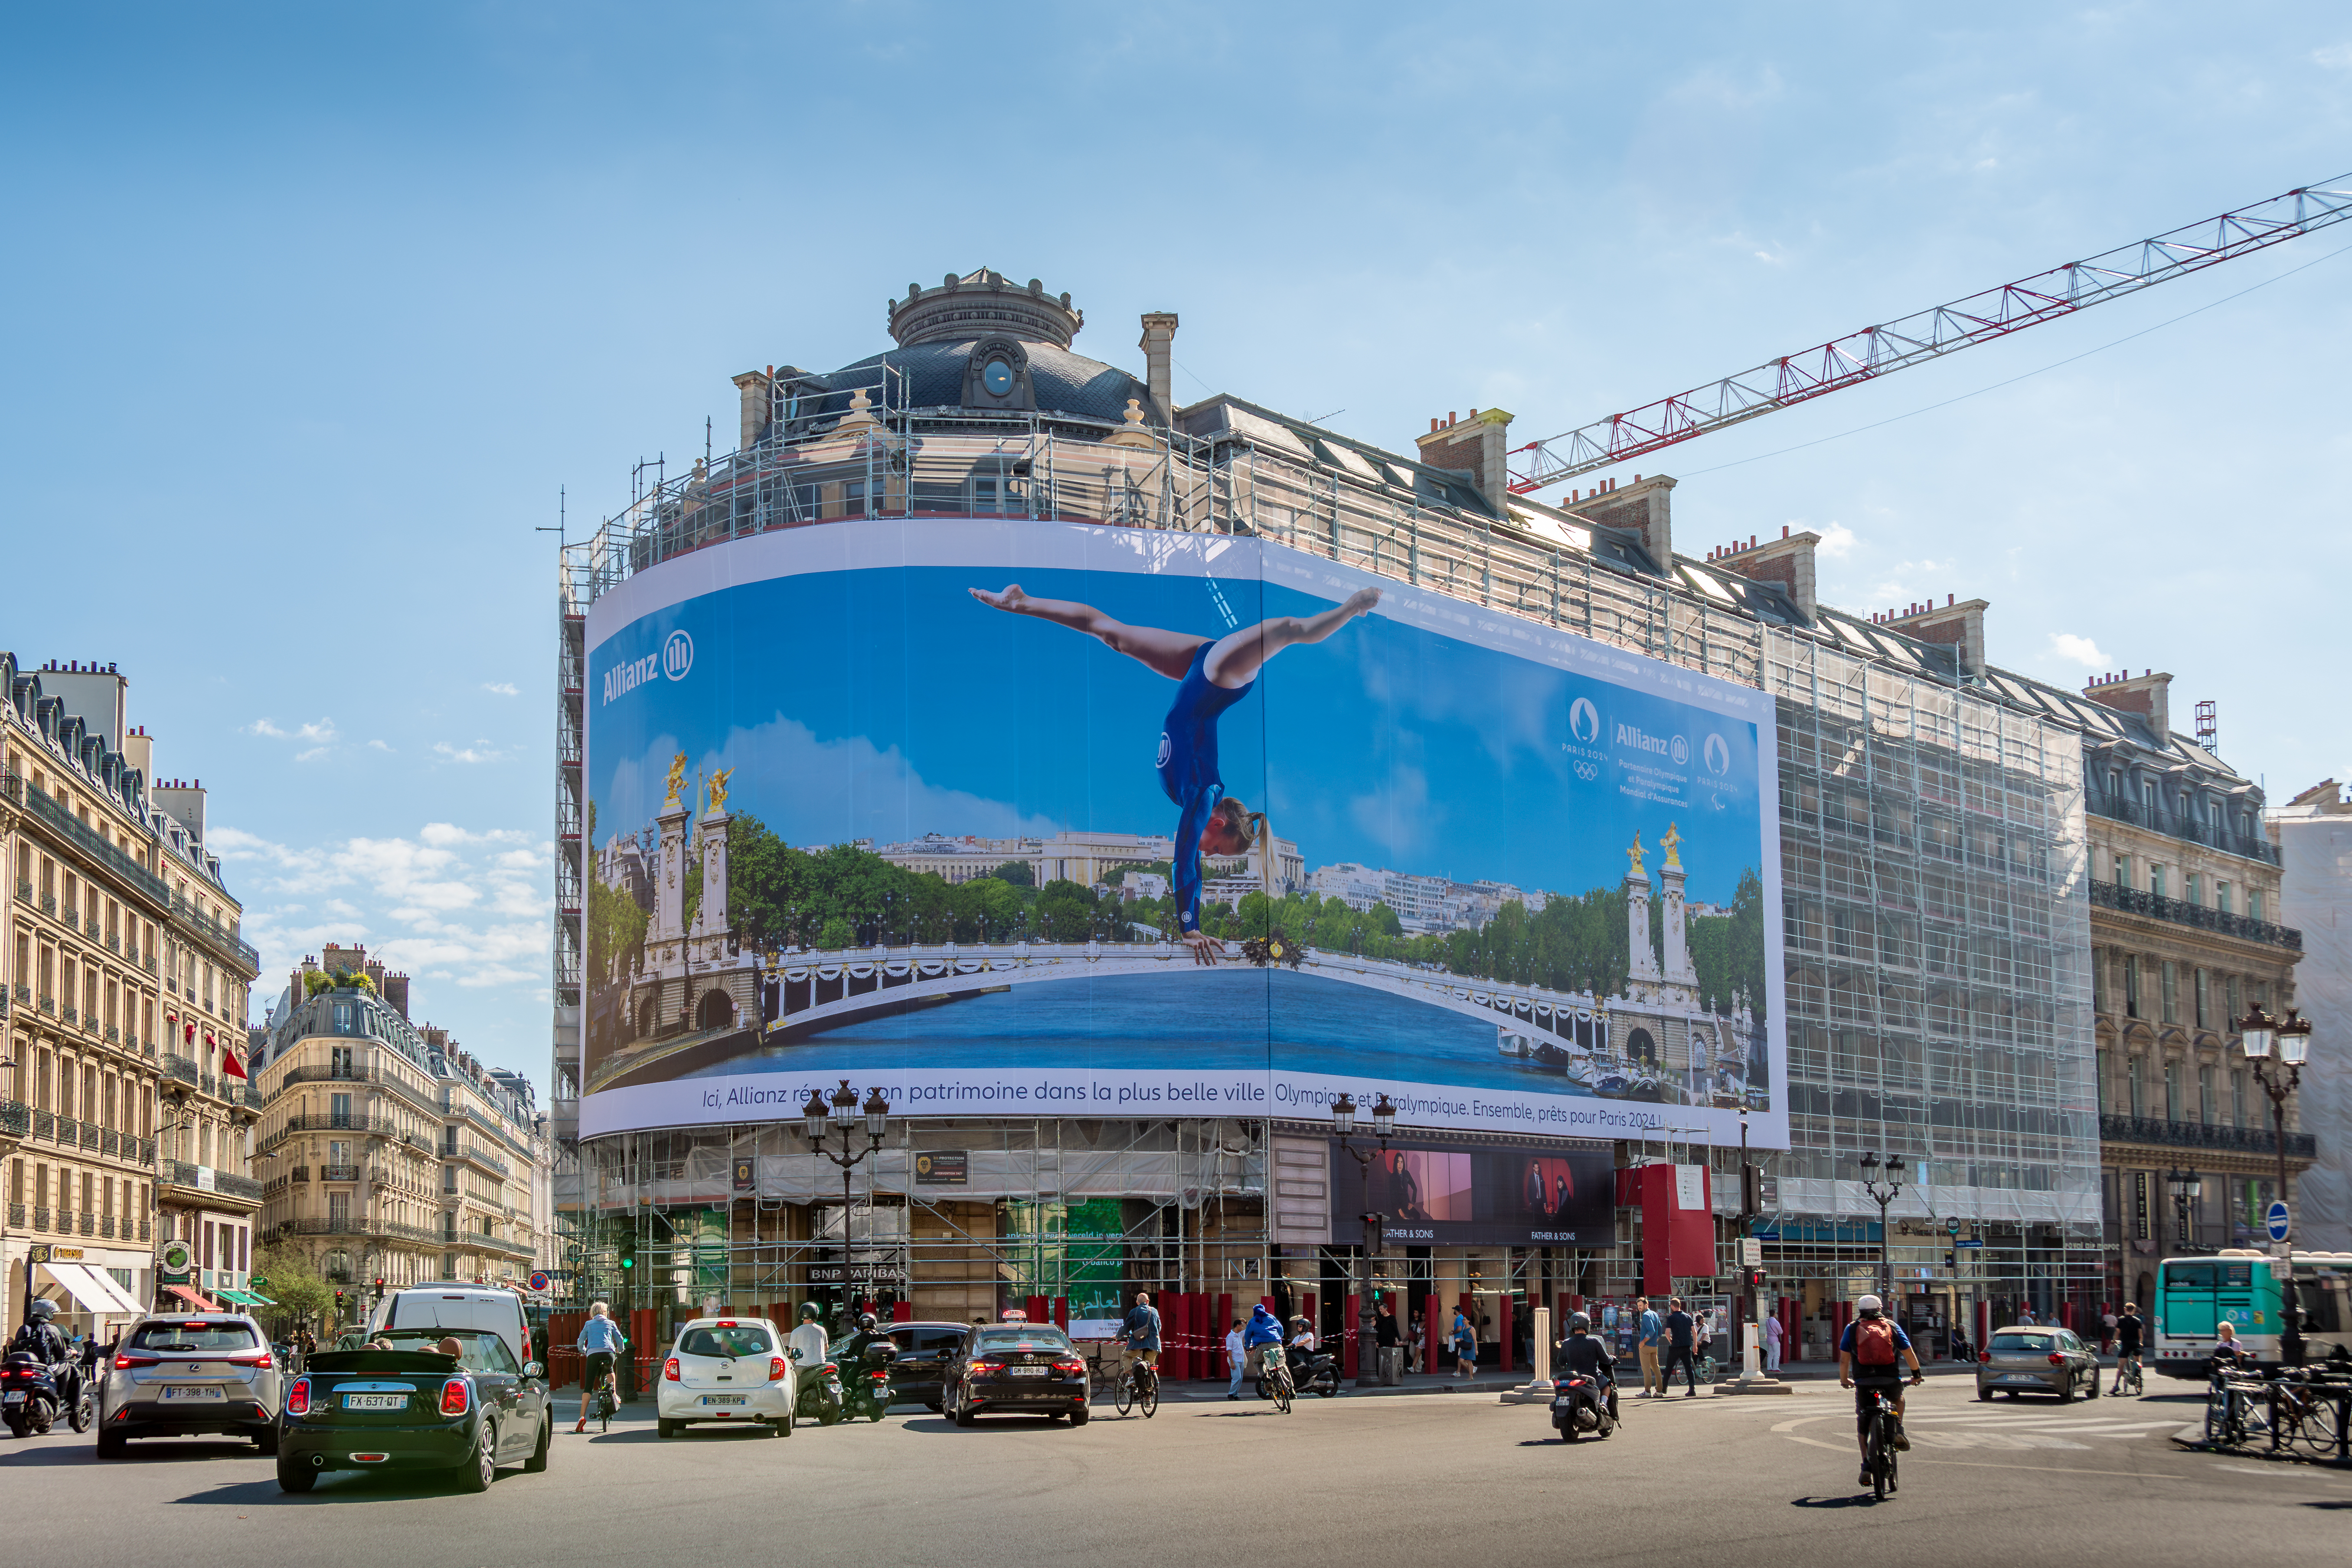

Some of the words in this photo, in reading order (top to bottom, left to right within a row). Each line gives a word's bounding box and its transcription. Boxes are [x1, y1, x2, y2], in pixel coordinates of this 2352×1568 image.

[603, 652, 658, 706] Allianz
[1617, 723, 1668, 756] Allianz
[1562, 743, 1585, 757] PARIS
[1588, 750, 1608, 761] 2024
[1618, 758, 1653, 774] Partenaire
[1654, 768, 1688, 784] Olympique
[1619, 785, 1646, 798] Mondial
[1636, 776, 1679, 795] Paralympique
[1697, 776, 1717, 789] PARIS
[1719, 781, 1738, 793] 2024
[702, 1089, 722, 1110] Ici,
[726, 1086, 787, 1106] Allianz
[910, 1081, 1028, 1103] patrimoine
[1034, 1081, 1086, 1100] dans
[1093, 1081, 1111, 1101] la
[1119, 1082, 1161, 1104] plus
[1168, 1082, 1218, 1101] belle
[1224, 1082, 1264, 1101] ville
[1358, 1092, 1372, 1107] et
[1473, 1100, 1535, 1122] Ensemble,
[1539, 1105, 1567, 1124] prêts
[1571, 1113, 1596, 1126] pour
[1599, 1110, 1626, 1127] Paris
[1629, 1112, 1656, 1128] 2024
[1383, 1229, 1408, 1238] ATHER
[1409, 1230, 1414, 1238] &
[1415, 1229, 1434, 1238] SONS
[1532, 1232, 1553, 1240] FATHER
[1560, 1232, 1575, 1241] SONS
[812, 1269, 842, 1279] BNP
[172, 1388, 215, 1397] FT-398-YH
[350, 1396, 399, 1406] FX-637-QT
